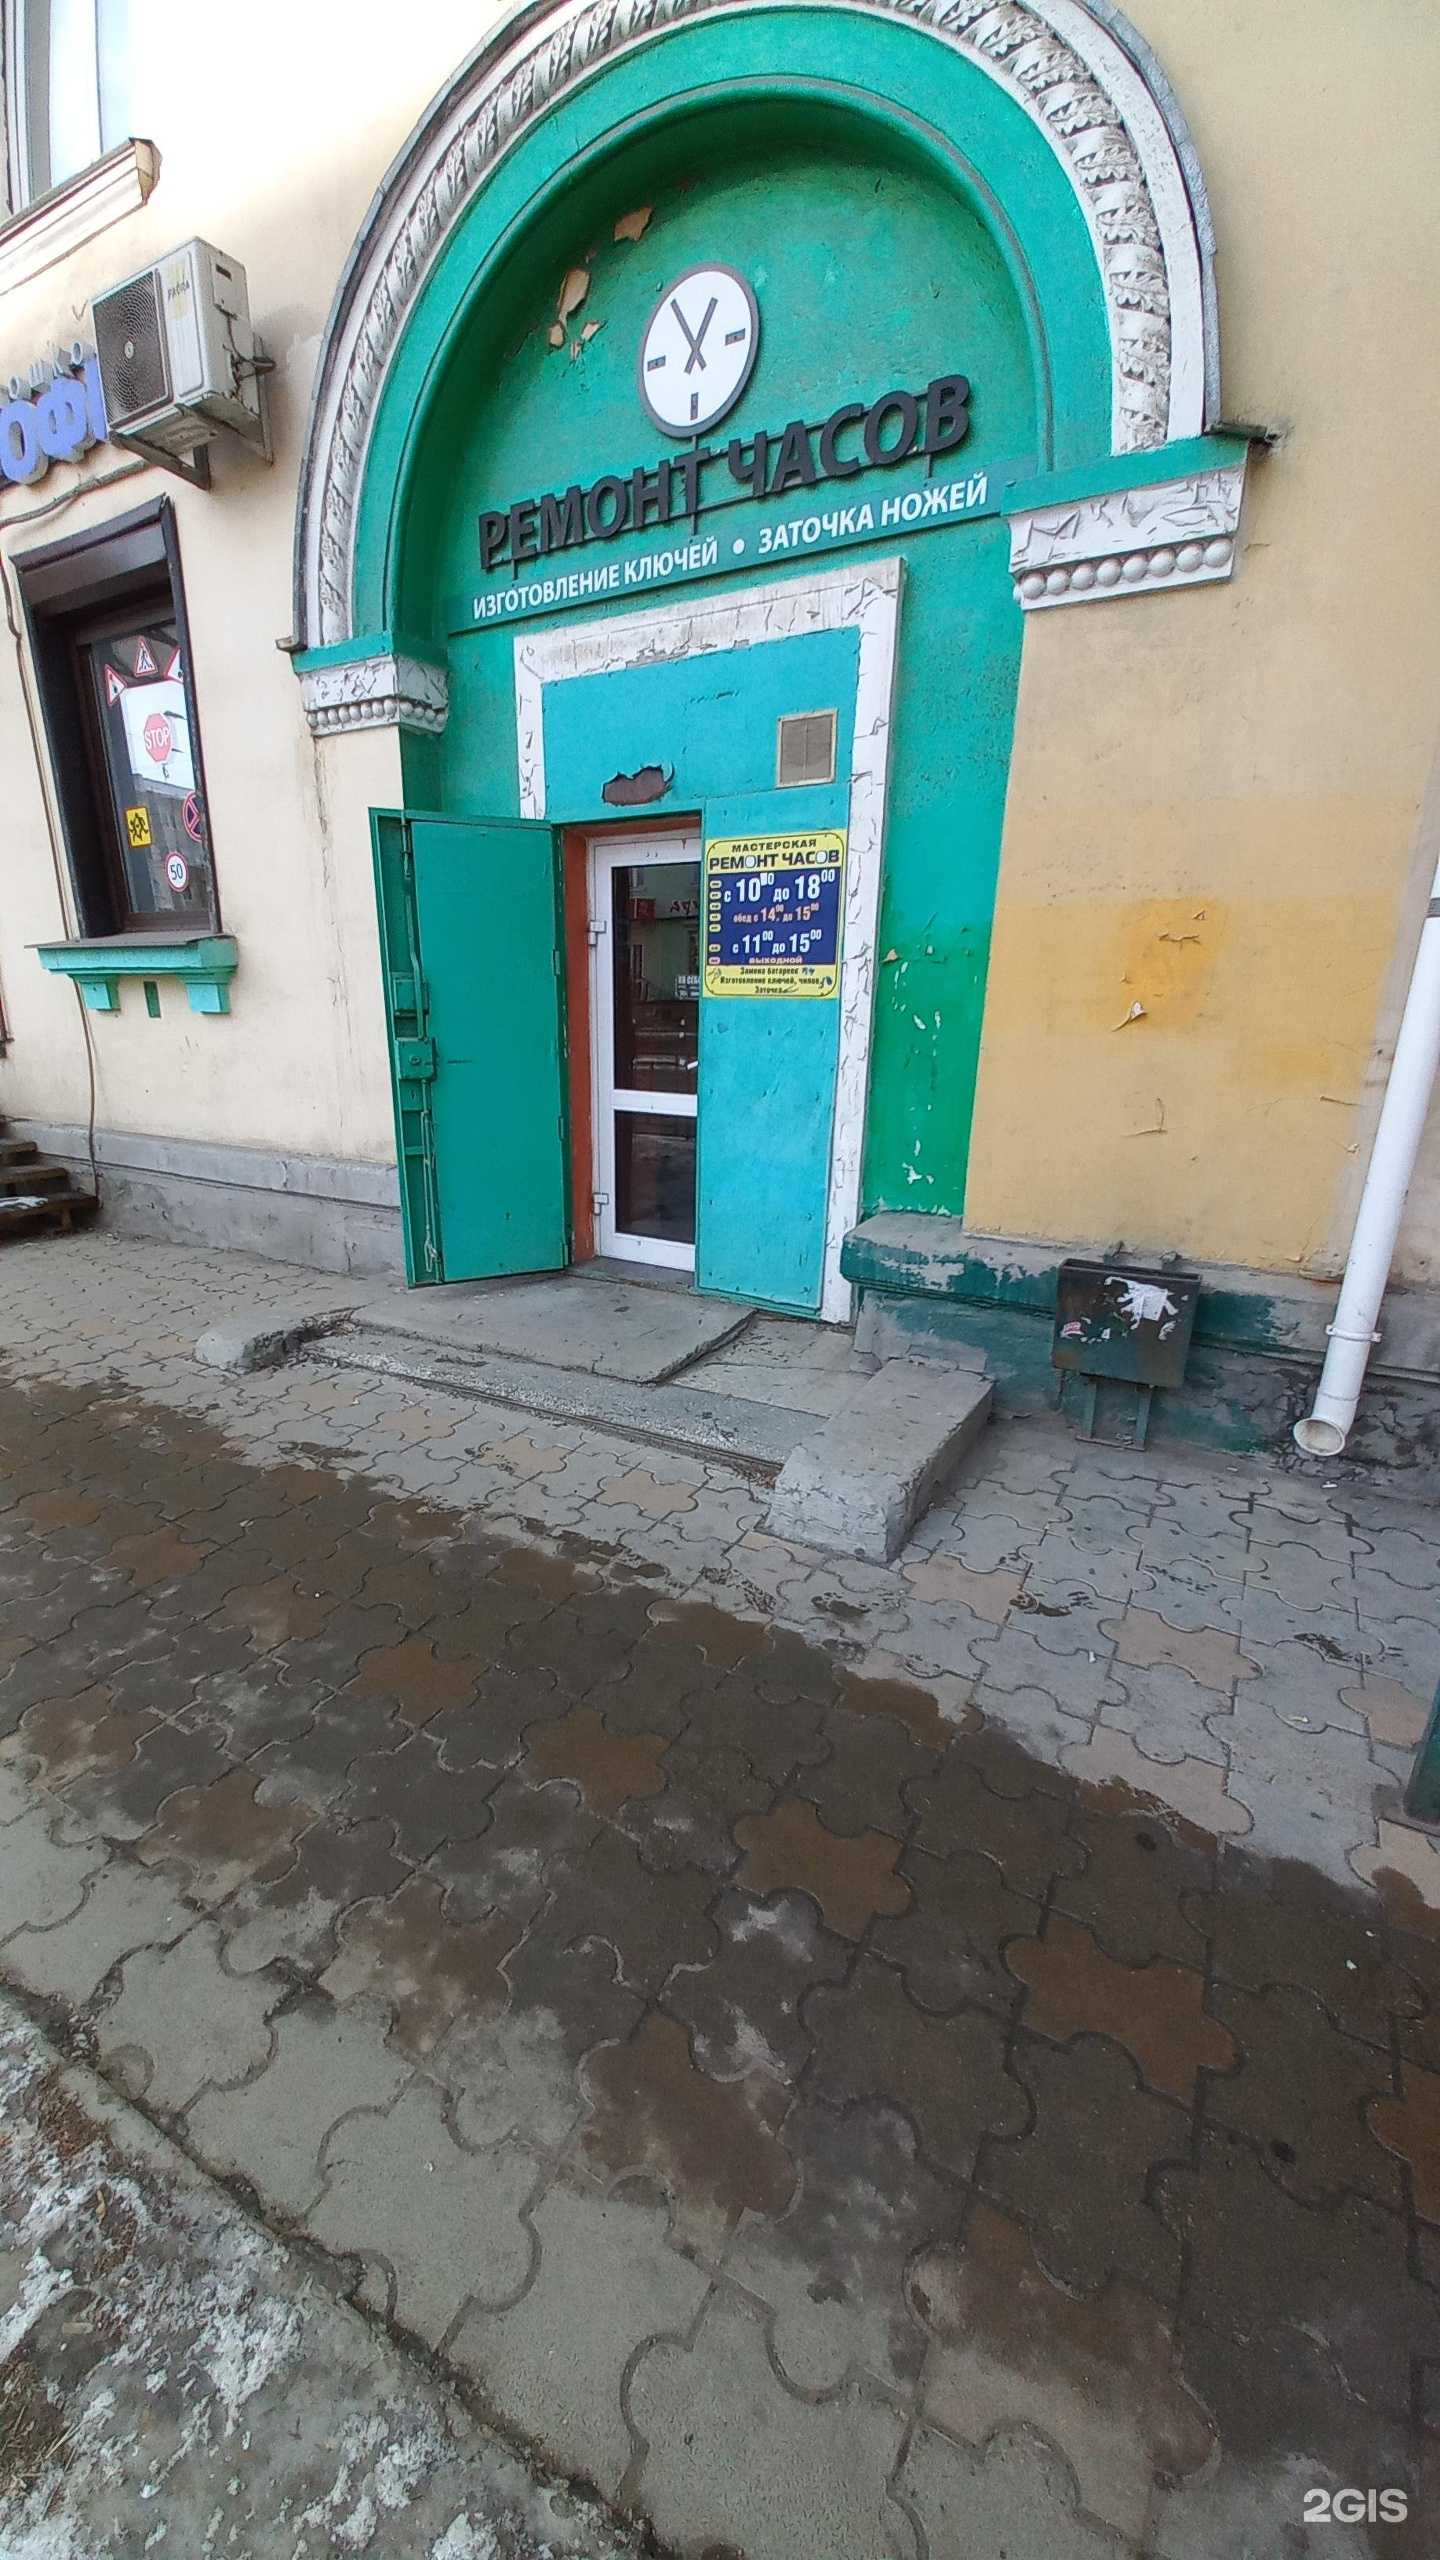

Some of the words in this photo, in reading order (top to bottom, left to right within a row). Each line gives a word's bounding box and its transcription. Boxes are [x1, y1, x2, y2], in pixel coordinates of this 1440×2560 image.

[478, 446, 710, 570] РЕМОНТ
[728, 374, 972, 498] ЧАСОВ
[472, 562, 621, 620] ИЗГОТОВЛЕНИЕ
[623, 536, 718, 585] КЛЮЧЕЙ
[758, 505, 874, 554] ЗАТОЧКА
[881, 470, 988, 530] НОЖЕЙ
[144, 728, 170, 750] STOP
[731, 839, 817, 853] МАСТЕРСКАЯ
[709, 853, 779, 870] РЕМОНТ
[782, 850, 840, 866] ЧАСОВ
[170, 863, 184, 880] 50
[773, 888, 790, 903] до
[771, 943, 786, 955] до
